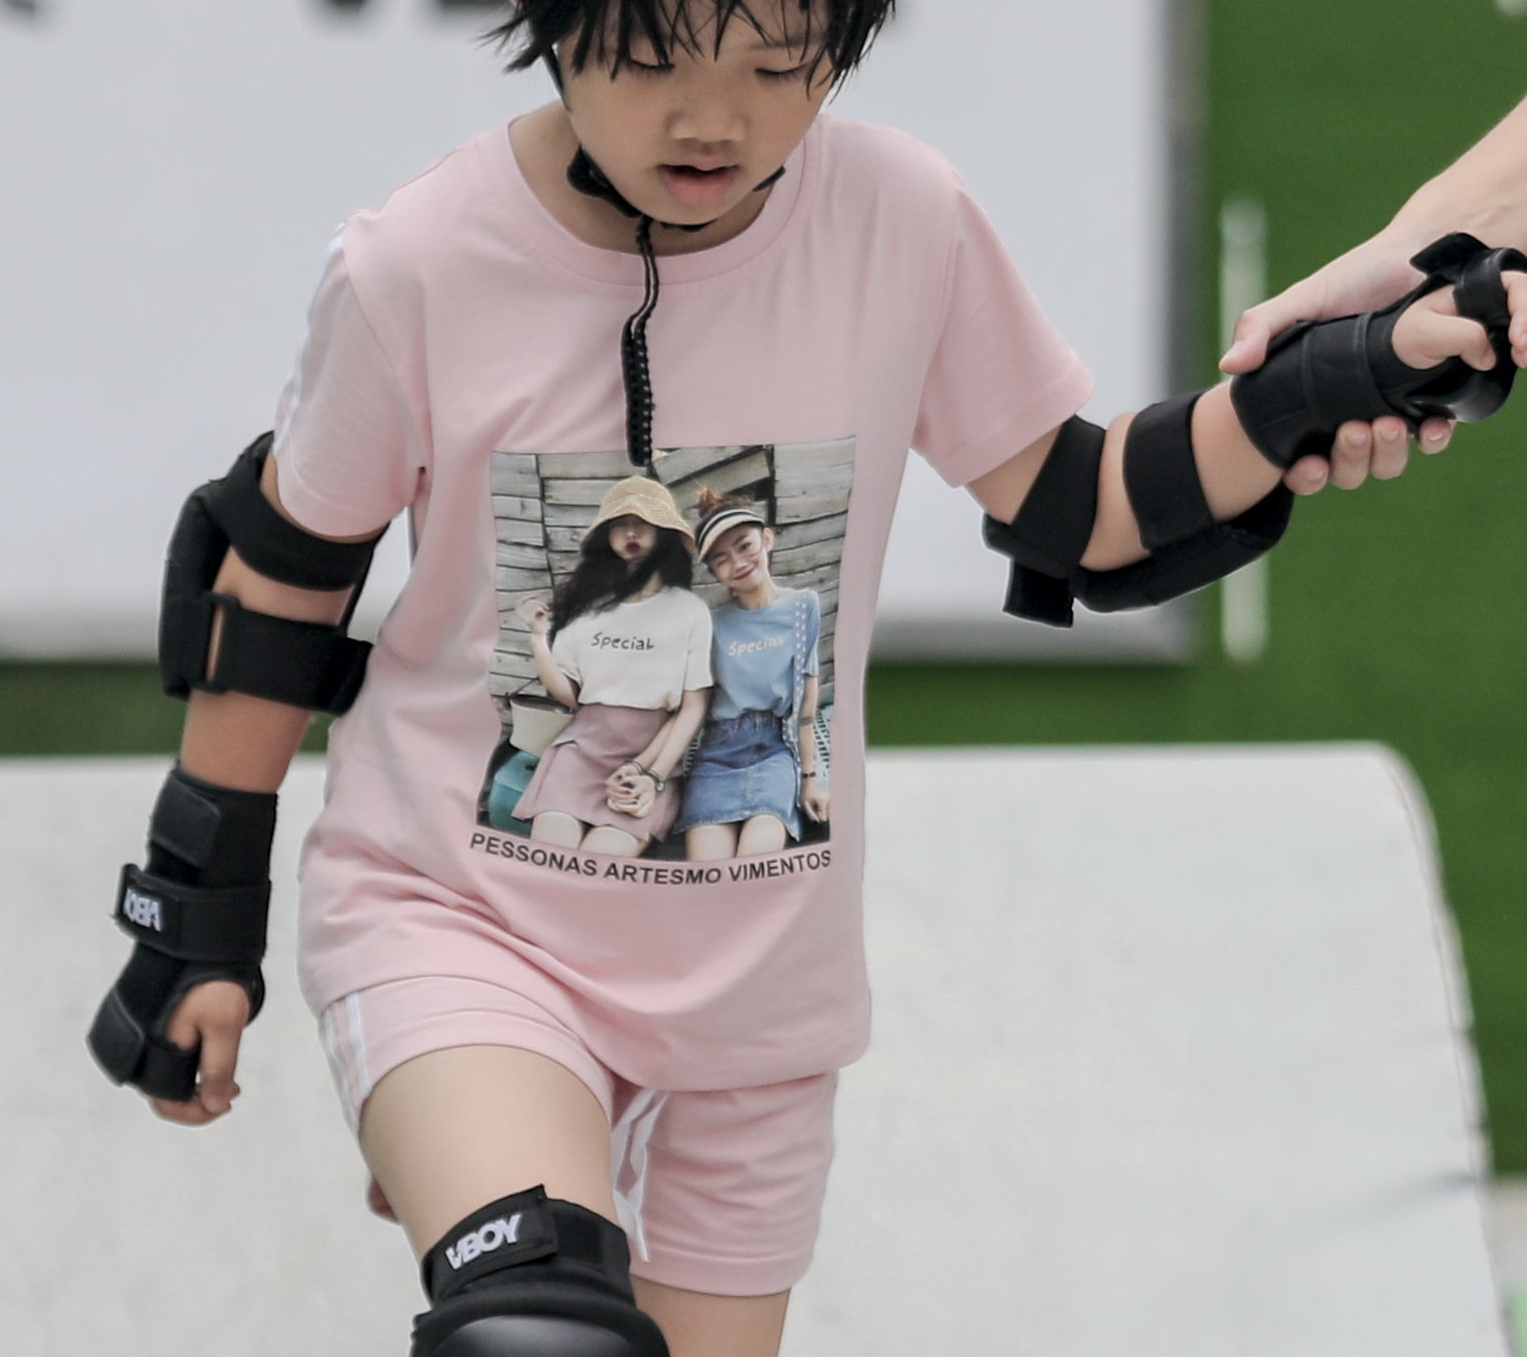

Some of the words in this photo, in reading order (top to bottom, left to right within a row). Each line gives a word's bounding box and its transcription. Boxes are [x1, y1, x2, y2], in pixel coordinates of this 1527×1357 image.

[591, 632, 655, 652] Special
[469, 832, 598, 877] PESSONAS
[604, 862, 722, 885] ARTESMO
[728, 849, 832, 883] VIMENTOS
[445, 1213, 523, 1271] VBOY
